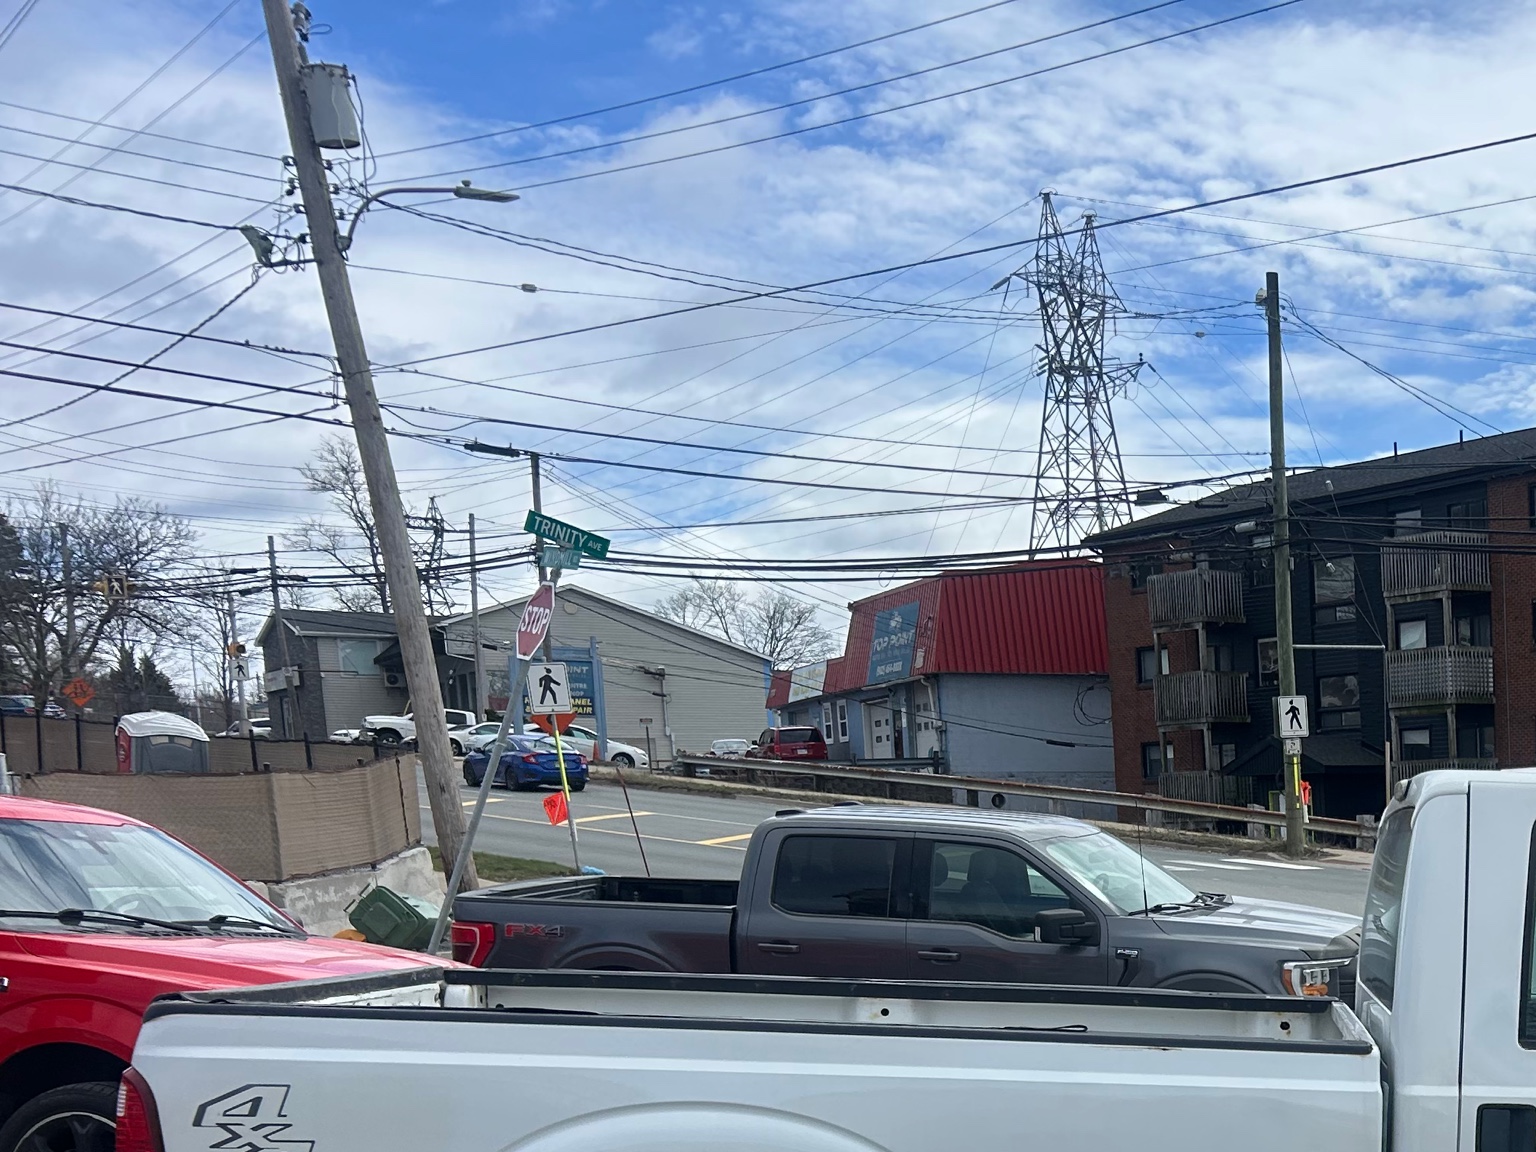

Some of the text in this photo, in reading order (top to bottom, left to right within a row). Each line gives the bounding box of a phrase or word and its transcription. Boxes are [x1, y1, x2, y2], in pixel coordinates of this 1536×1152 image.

[534, 516, 602, 551] TRINITY AVE
[521, 605, 550, 635] STOP
[872, 636, 889, 652] TOP
[505, 922, 565, 938] FX4
